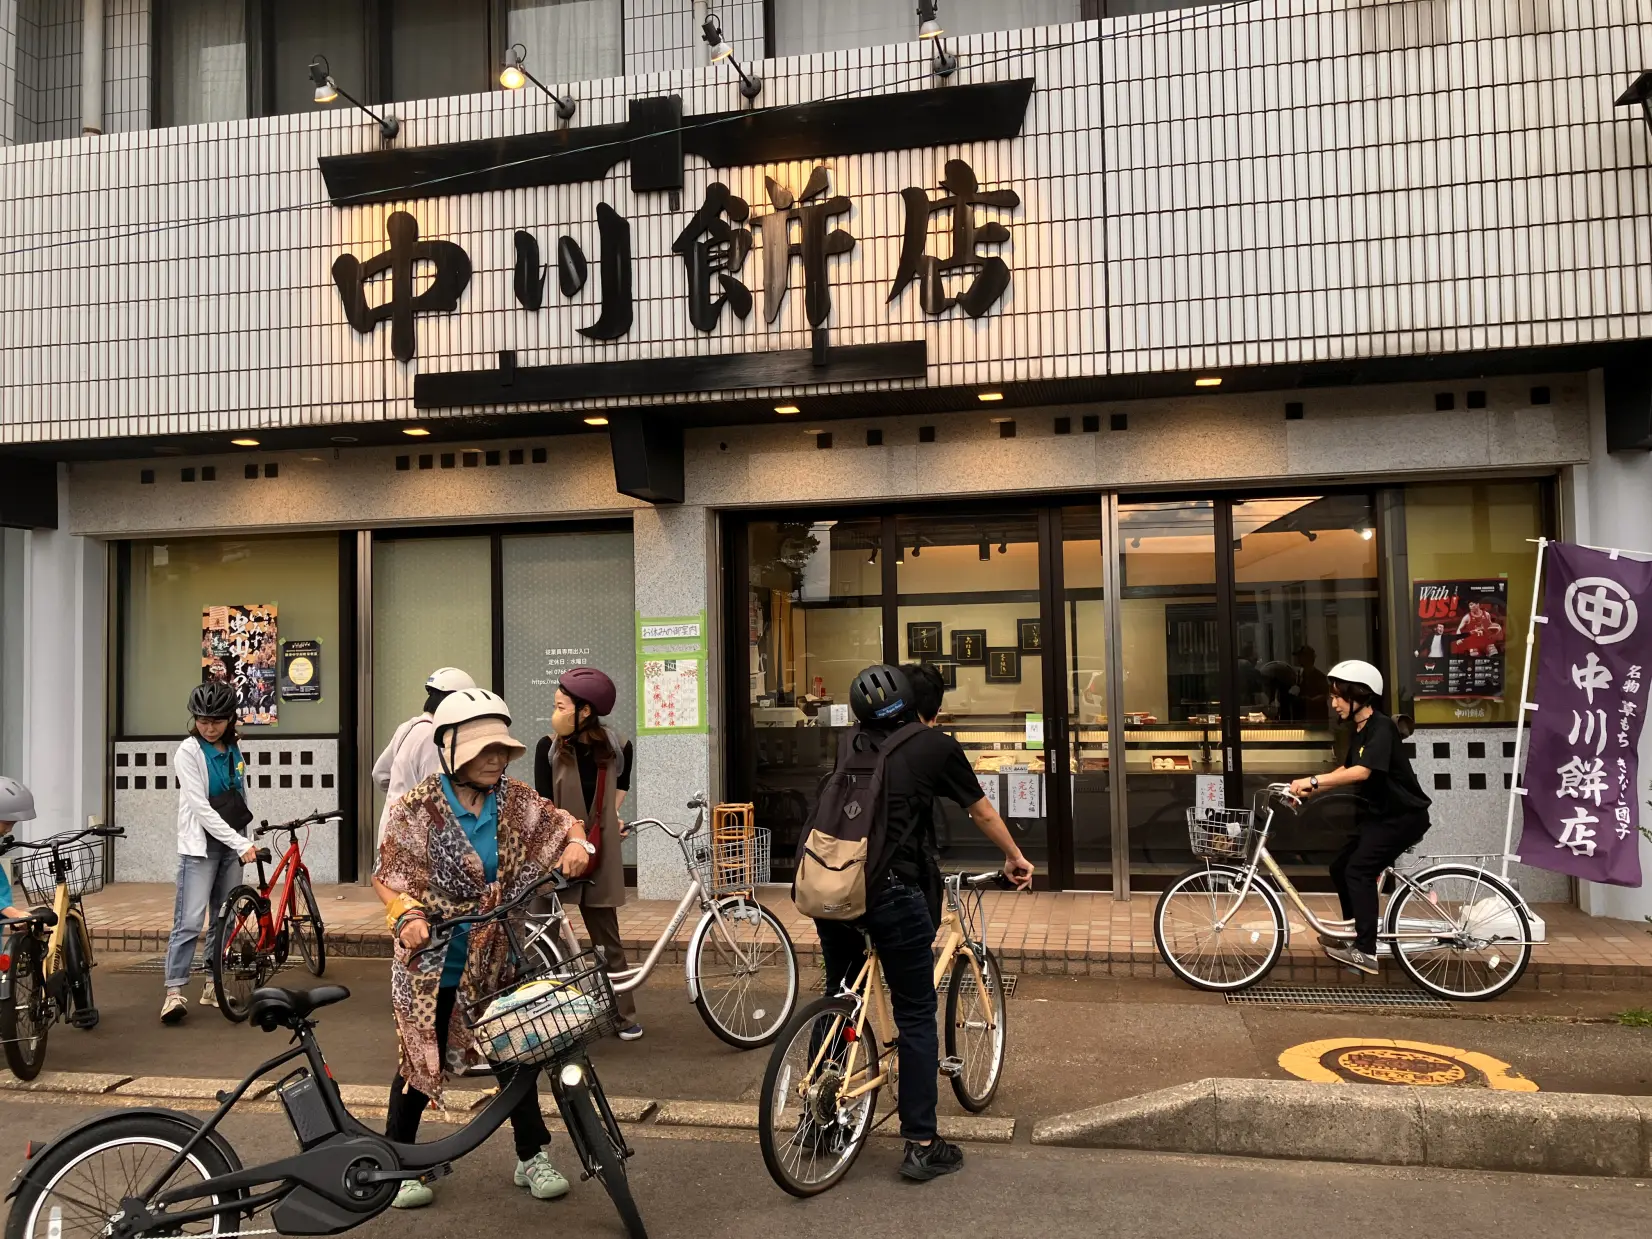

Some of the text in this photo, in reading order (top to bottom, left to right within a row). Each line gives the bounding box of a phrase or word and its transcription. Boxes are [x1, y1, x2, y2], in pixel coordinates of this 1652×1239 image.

[331, 158, 1021, 363] 中川餅店
[1418, 595, 1458, 618] US!
[1419, 585, 1449, 601] With
[1554, 652, 1612, 857] 中川餅店
[1614, 665, 1642, 840] 名物 草もち きなこ団子
[1018, 781, 1027, 800] 完売
[1028, 779, 1036, 812] えんどう大福
[1207, 783, 1216, 801] 完売
